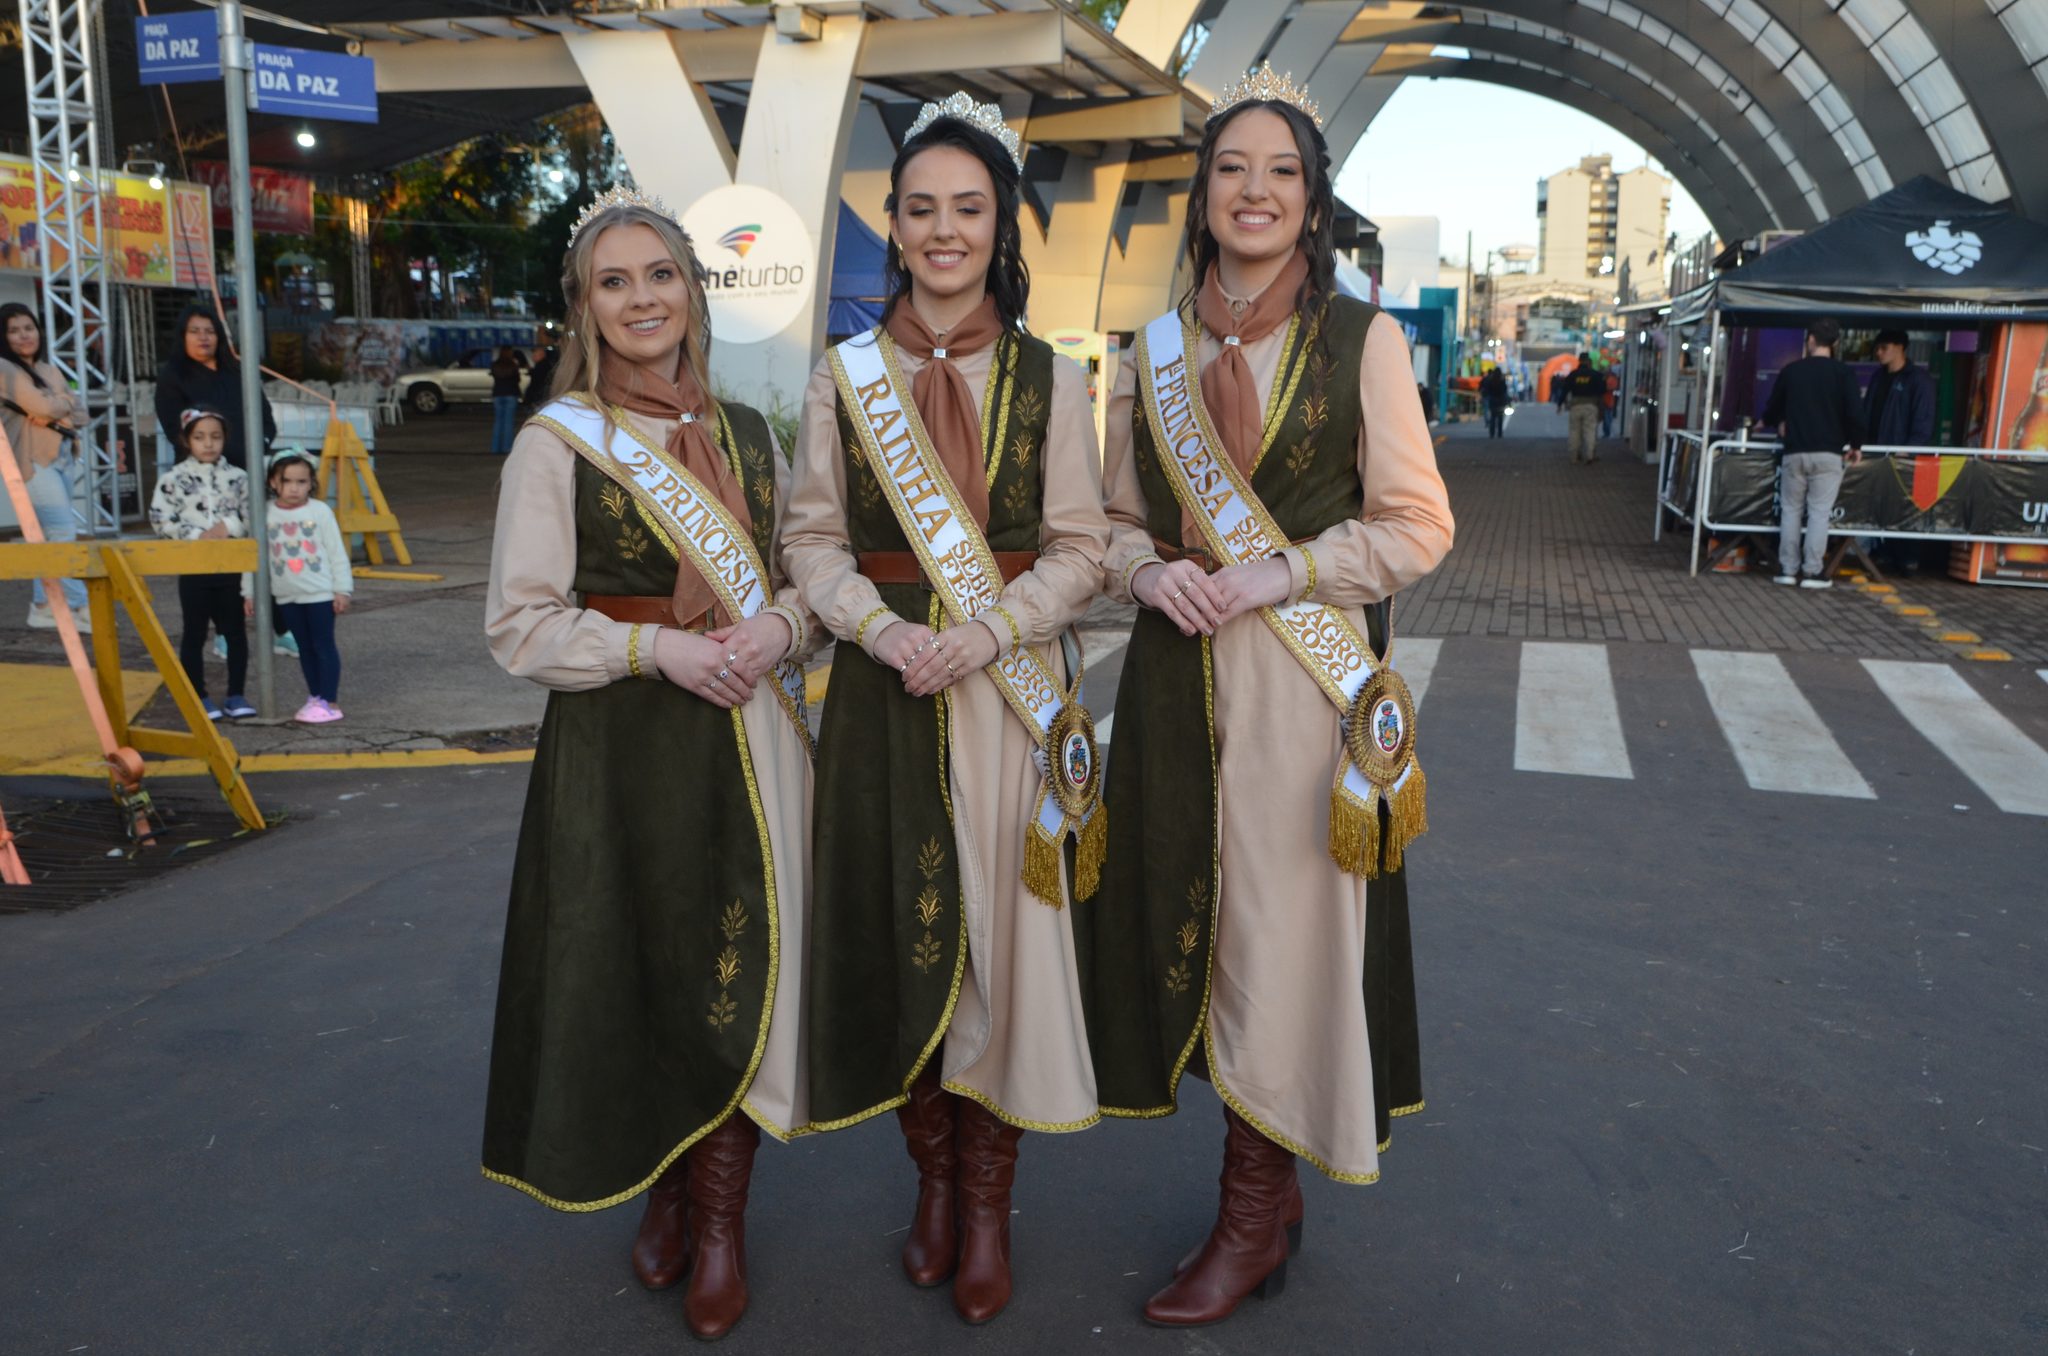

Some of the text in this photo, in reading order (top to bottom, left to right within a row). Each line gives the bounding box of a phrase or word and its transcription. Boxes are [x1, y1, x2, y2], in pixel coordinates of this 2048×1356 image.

[144, 23, 168, 37] PRAÇA
[145, 39, 199, 60] DA PAZ
[258, 52, 294, 68] PRAÇA
[259, 70, 340, 96] DA PAZ
[856, 373, 953, 544] RAINHA
[1157, 373, 1234, 520] PRINCESA
[650, 473, 758, 608] PRINCESA
[936, 549, 1043, 714] FES 026
[1285, 611, 1348, 682] 2026
[1303, 608, 1362, 671] AGRO
[1011, 643, 1053, 704] GRO
